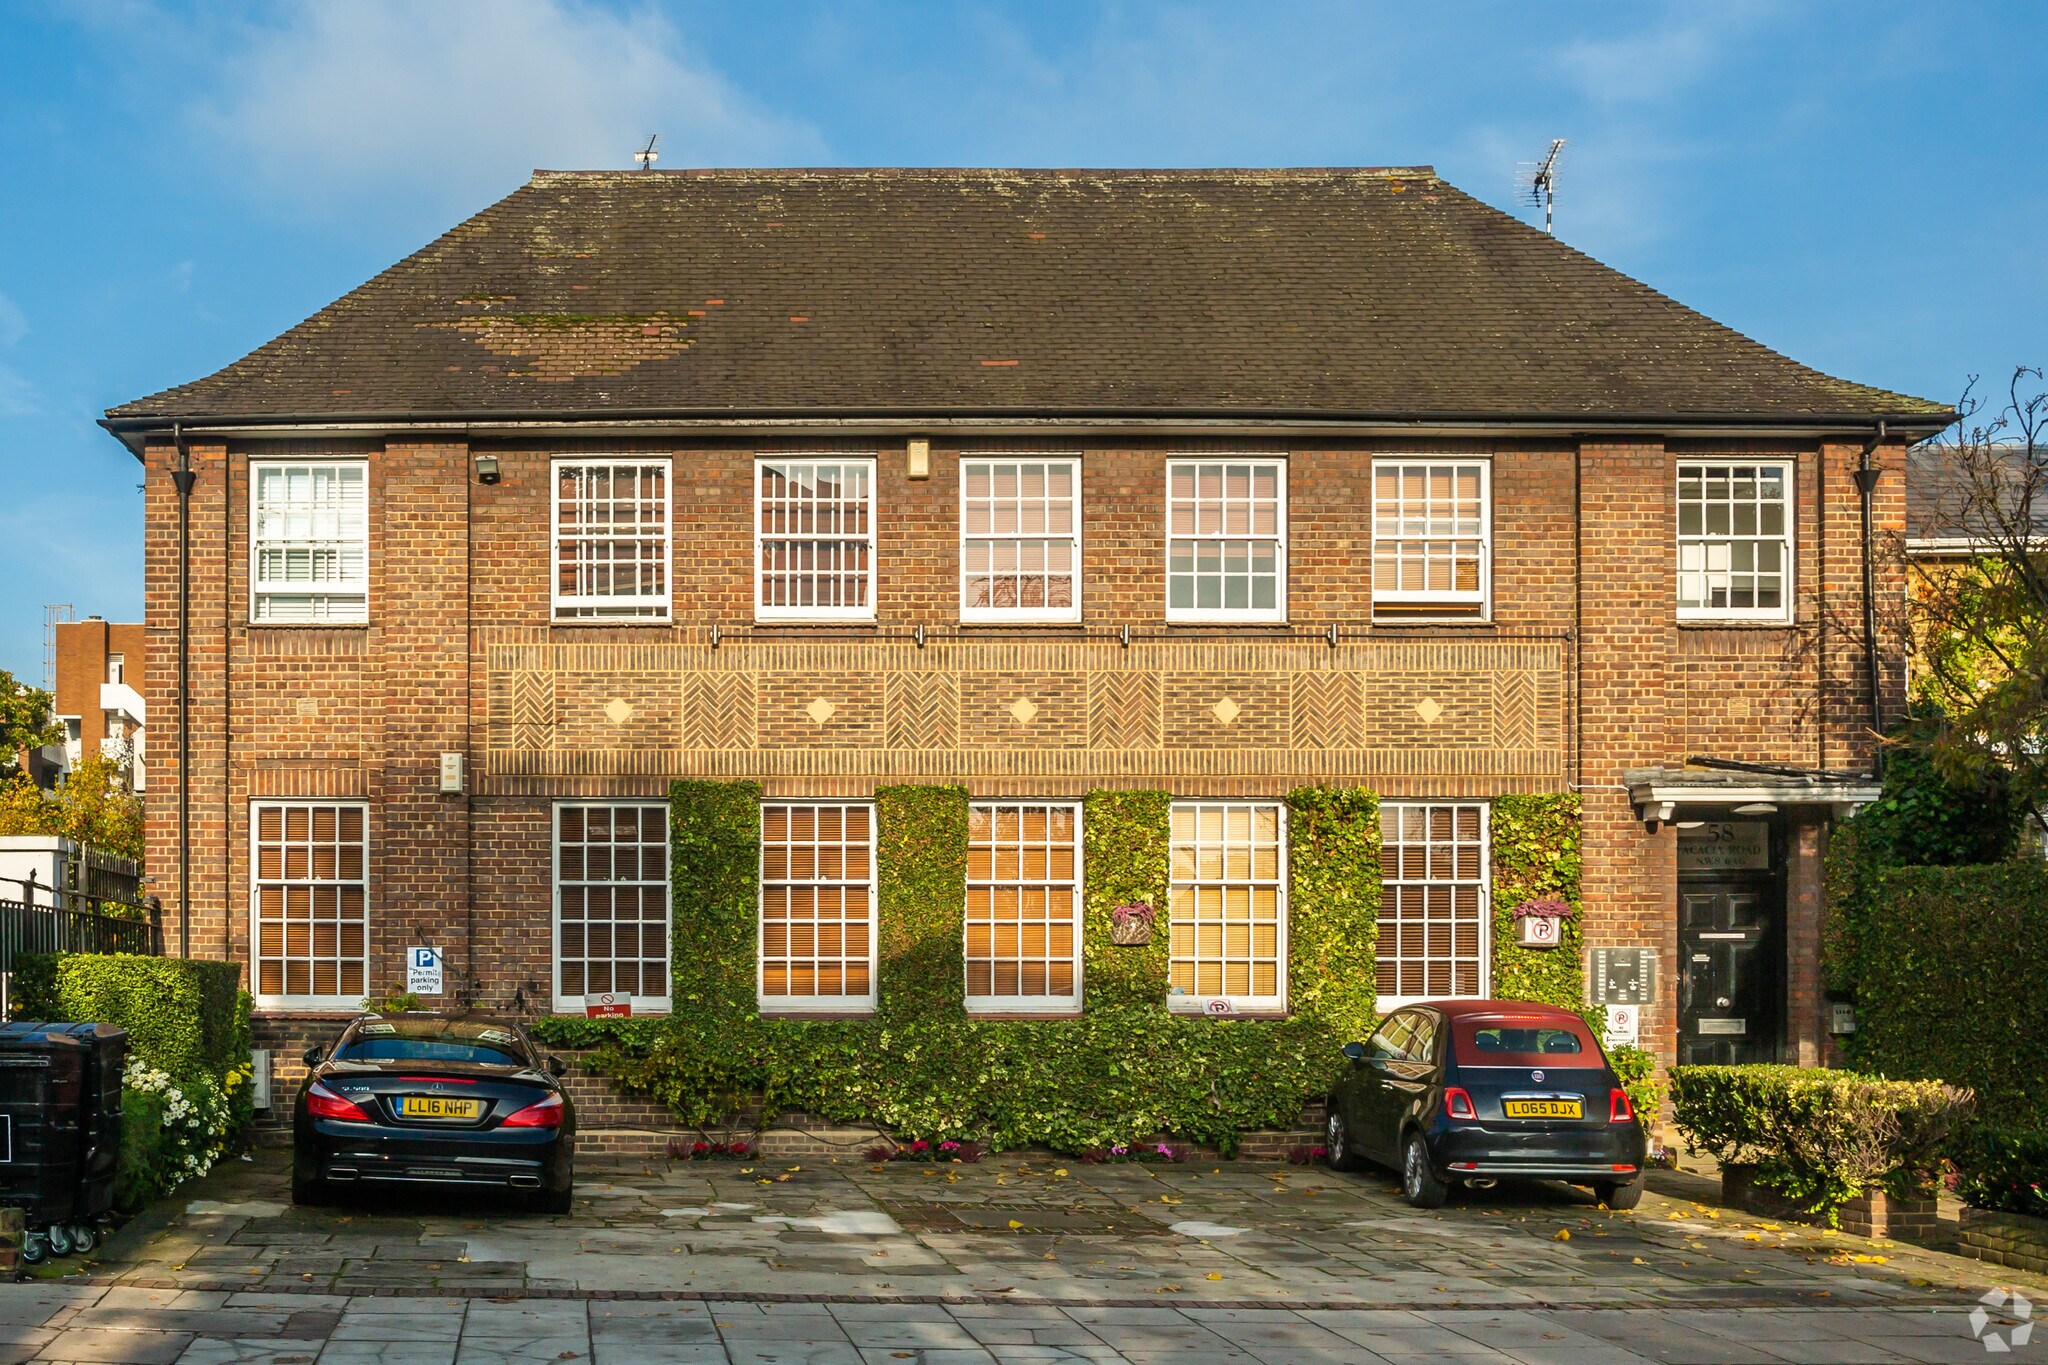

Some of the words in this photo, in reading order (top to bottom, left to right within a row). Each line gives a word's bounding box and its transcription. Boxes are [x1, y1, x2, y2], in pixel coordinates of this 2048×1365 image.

[1708, 823, 1735, 842] 58
[1682, 845, 1724, 855] ACACIA
[1728, 845, 1761, 855] ROAD
[419, 950, 432, 966] P
[410, 977, 440, 985] parking
[416, 984, 433, 992] only
[408, 1099, 441, 1114] LL16
[444, 1100, 473, 1115] NHP
[1512, 1103, 1547, 1115] LO65
[1550, 1103, 1576, 1116] DJX
